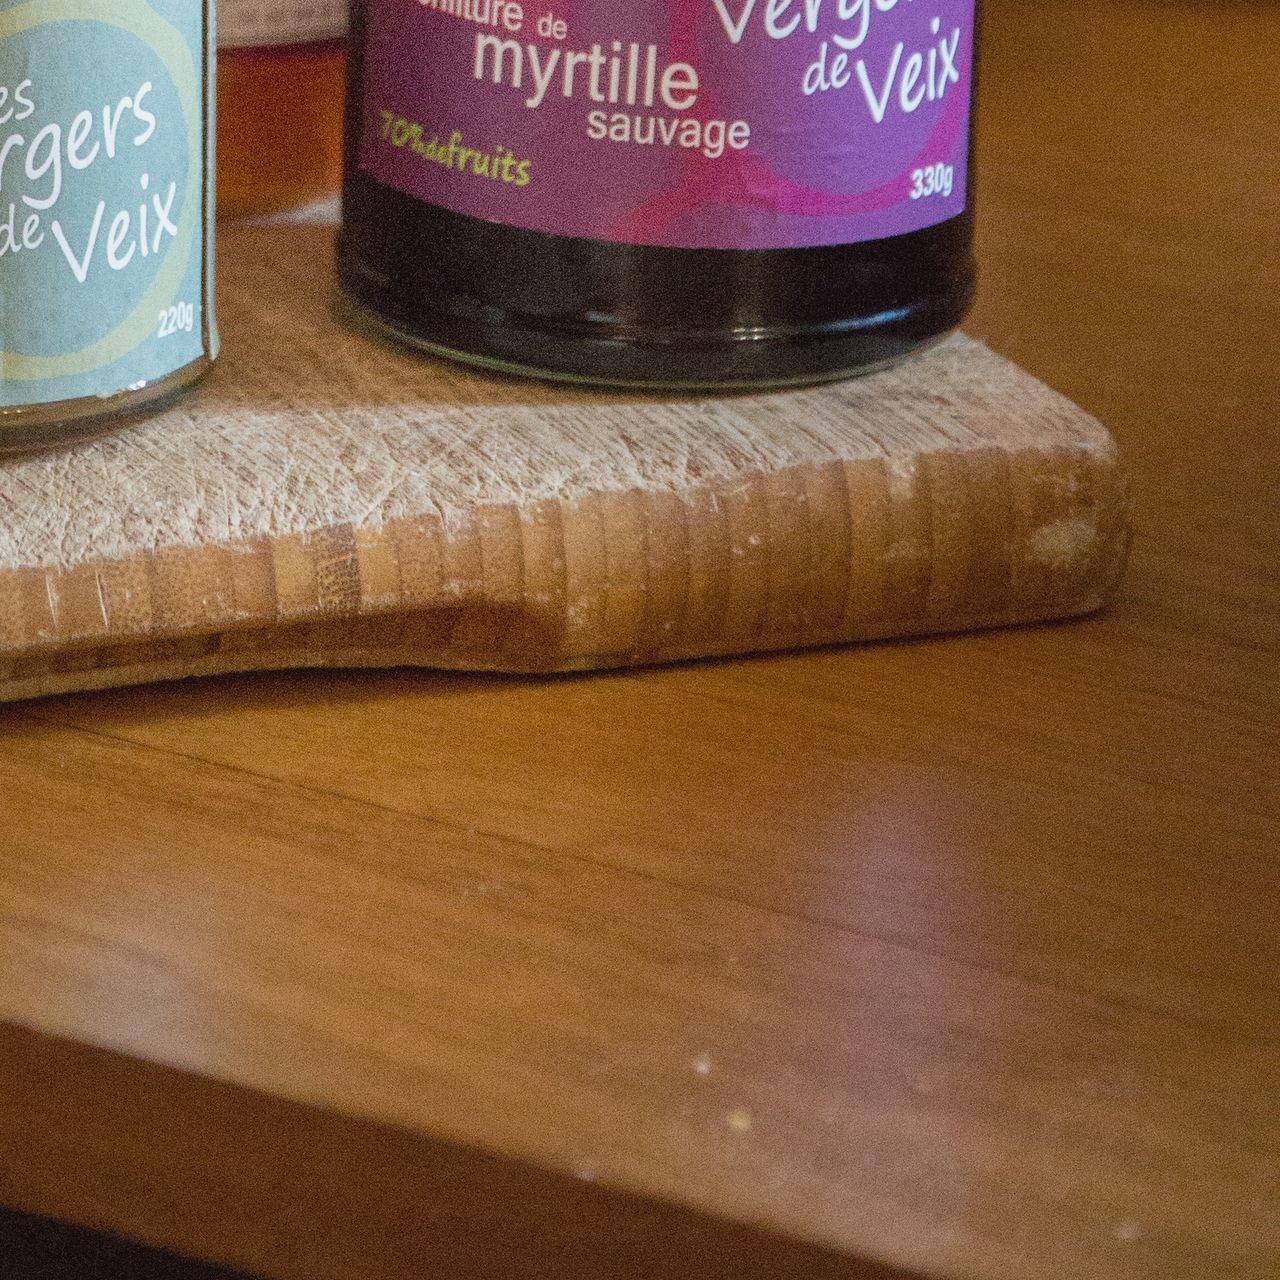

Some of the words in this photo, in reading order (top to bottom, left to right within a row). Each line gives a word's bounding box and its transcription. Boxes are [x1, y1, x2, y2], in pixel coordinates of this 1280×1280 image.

[537, 11, 569, 42] de
[474, 30, 700, 111] myrtille
[802, 41, 851, 96] de
[856, 16, 960, 124] Veix
[448, 129, 532, 187] fruits
[586, 109, 752, 159] sauvage
[909, 162, 954, 200] 330g
[50, 172, 179, 284] Veix
[157, 300, 194, 339] 220g
